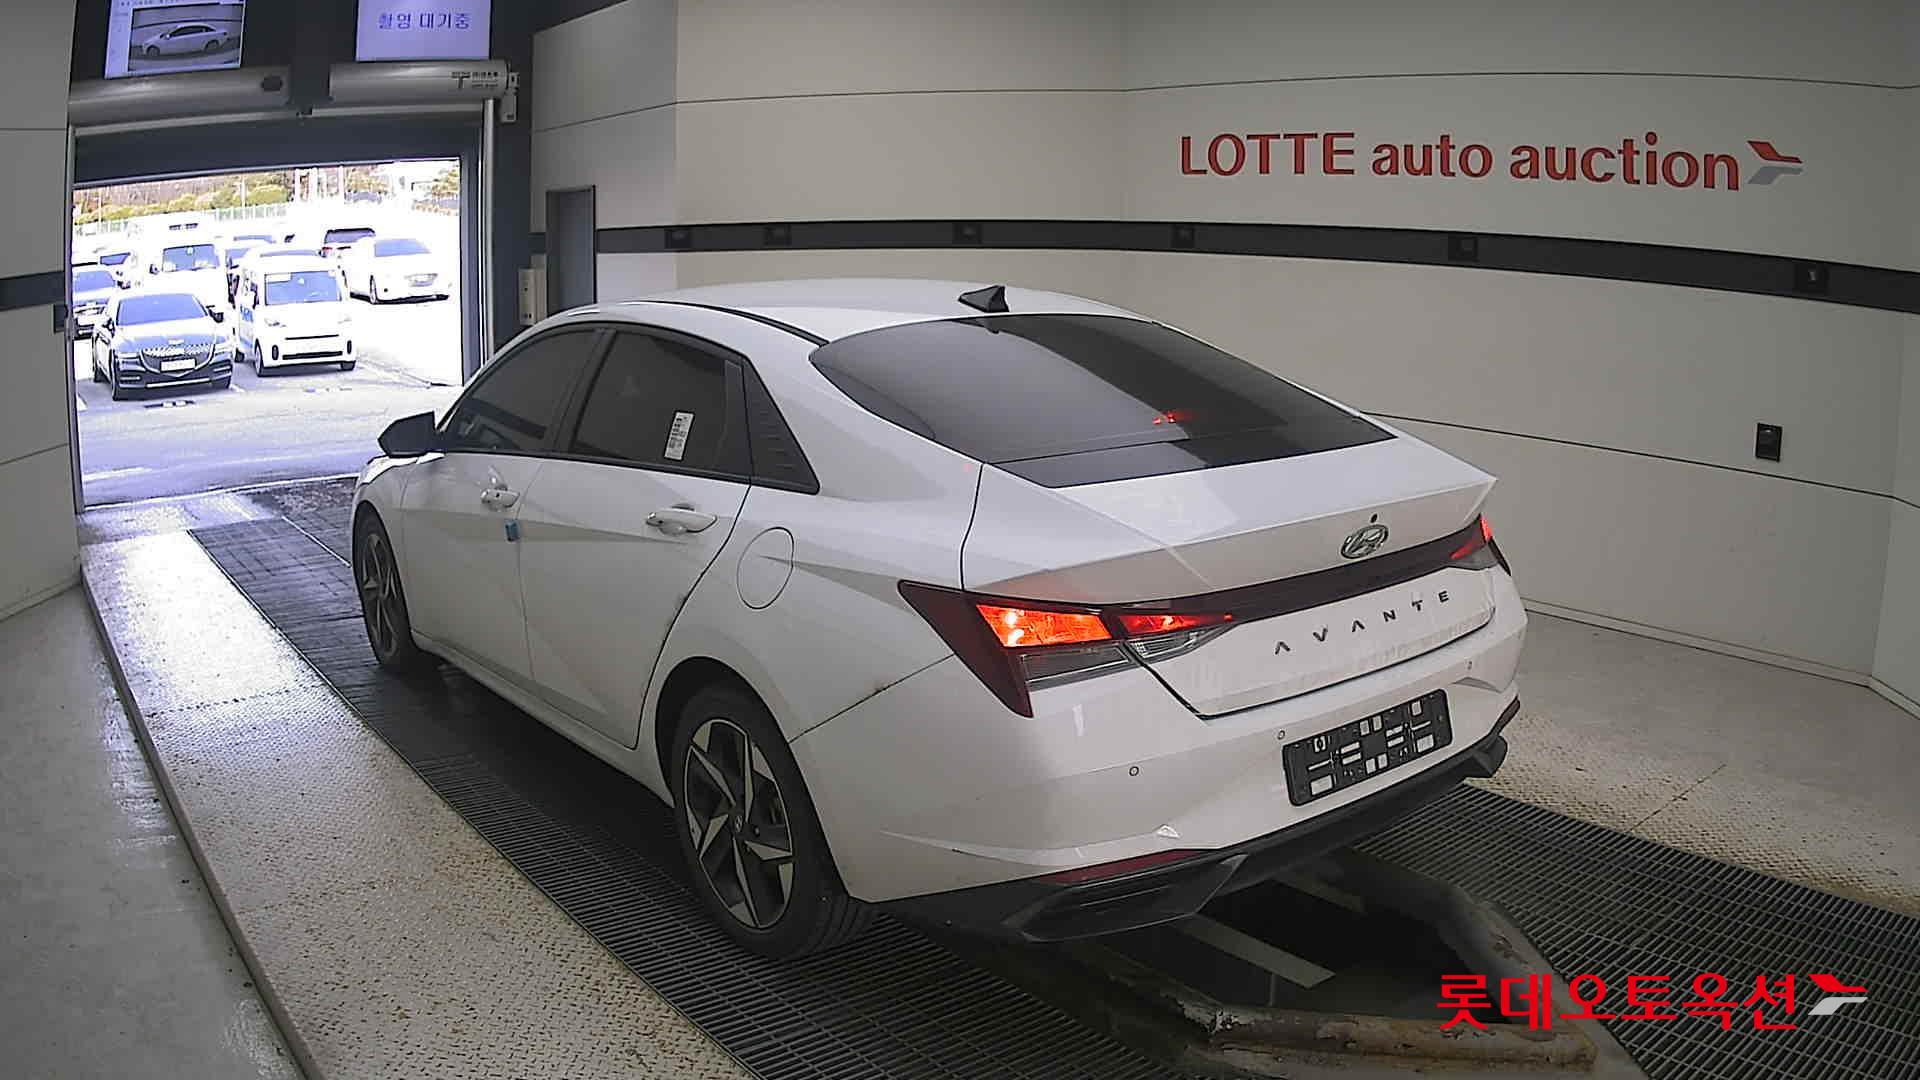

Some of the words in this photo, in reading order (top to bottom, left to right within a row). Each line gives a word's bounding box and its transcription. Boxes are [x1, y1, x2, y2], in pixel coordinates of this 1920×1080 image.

[419, 13, 470, 30] 대기중
[1180, 131, 1356, 177] LOTTE
[1371, 134, 1494, 178] auto
[1509, 131, 1740, 191] auction
[1274, 590, 1451, 655] AVANTE
